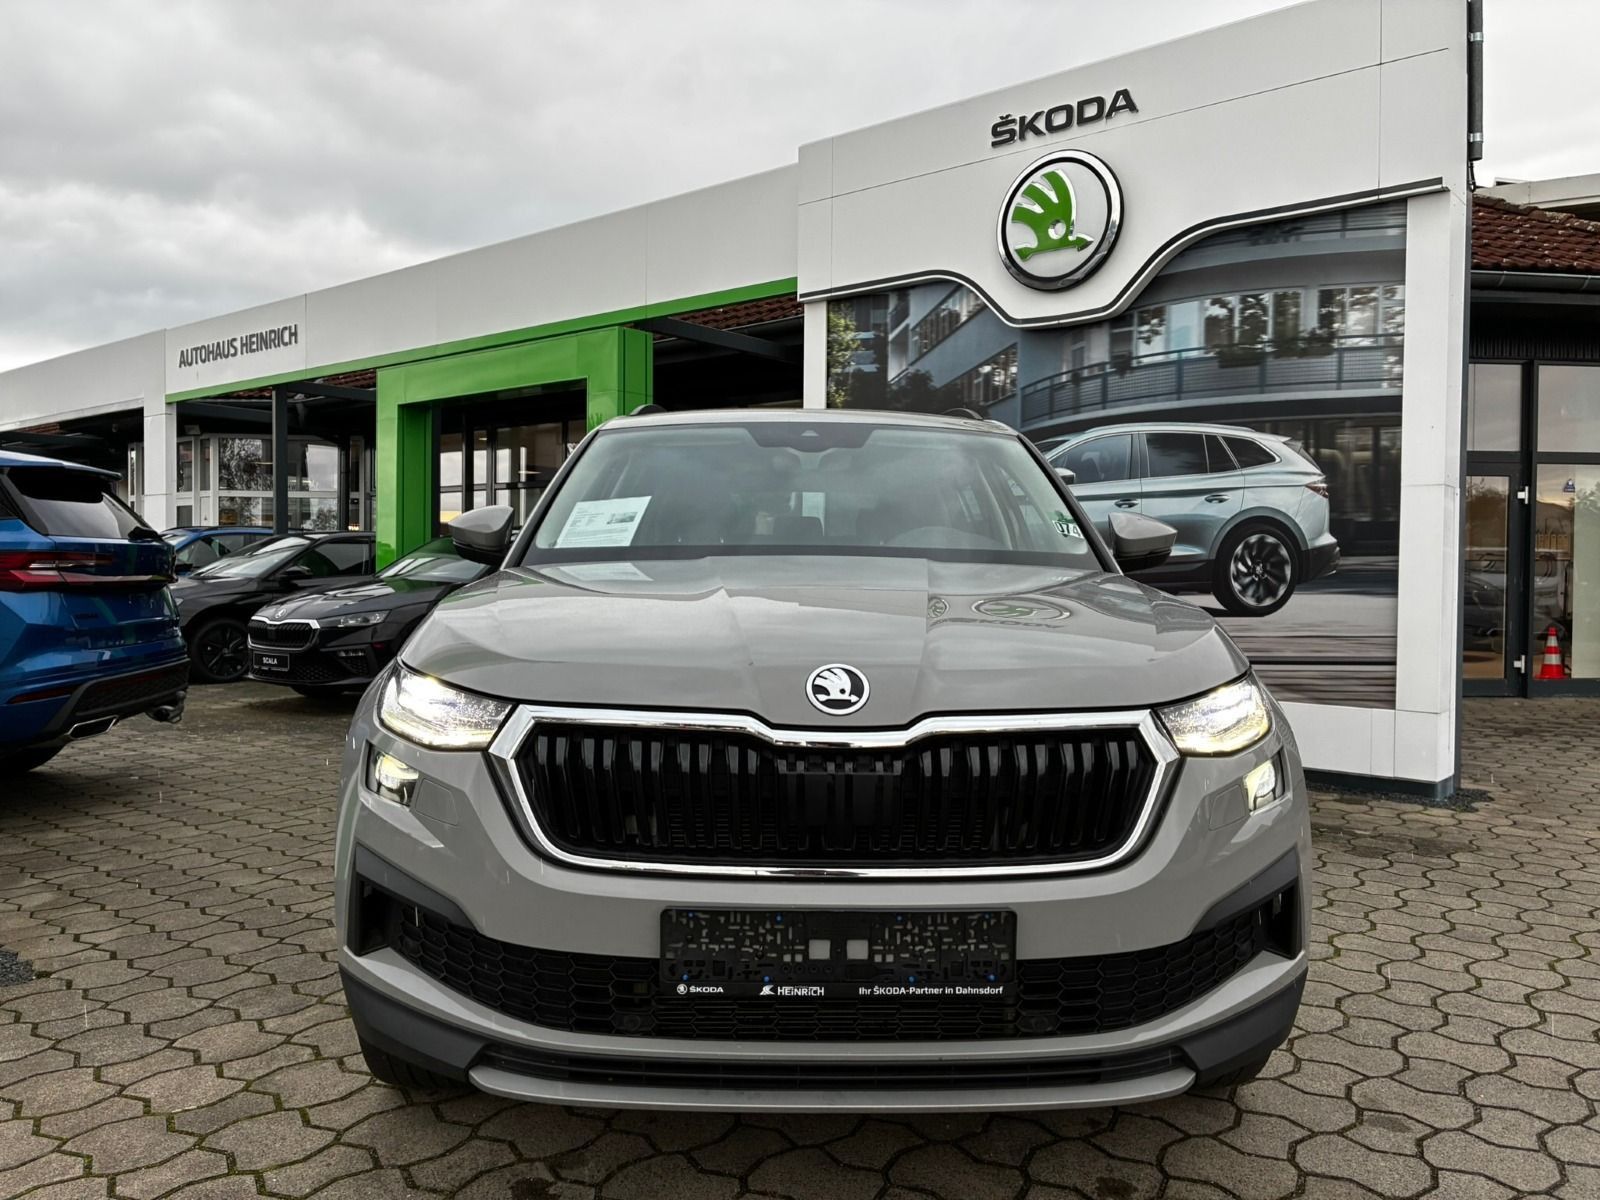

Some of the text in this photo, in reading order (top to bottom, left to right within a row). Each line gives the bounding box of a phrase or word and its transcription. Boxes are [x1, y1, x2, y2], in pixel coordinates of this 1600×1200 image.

[991, 88, 1139, 148] ŠKODA
[178, 324, 298, 369] AUTOHAUS HEINRICH
[689, 985, 724, 993] ŠKODA
[858, 985, 1004, 995] Ihr ŠKODA-Partner in Dahnsdorf
